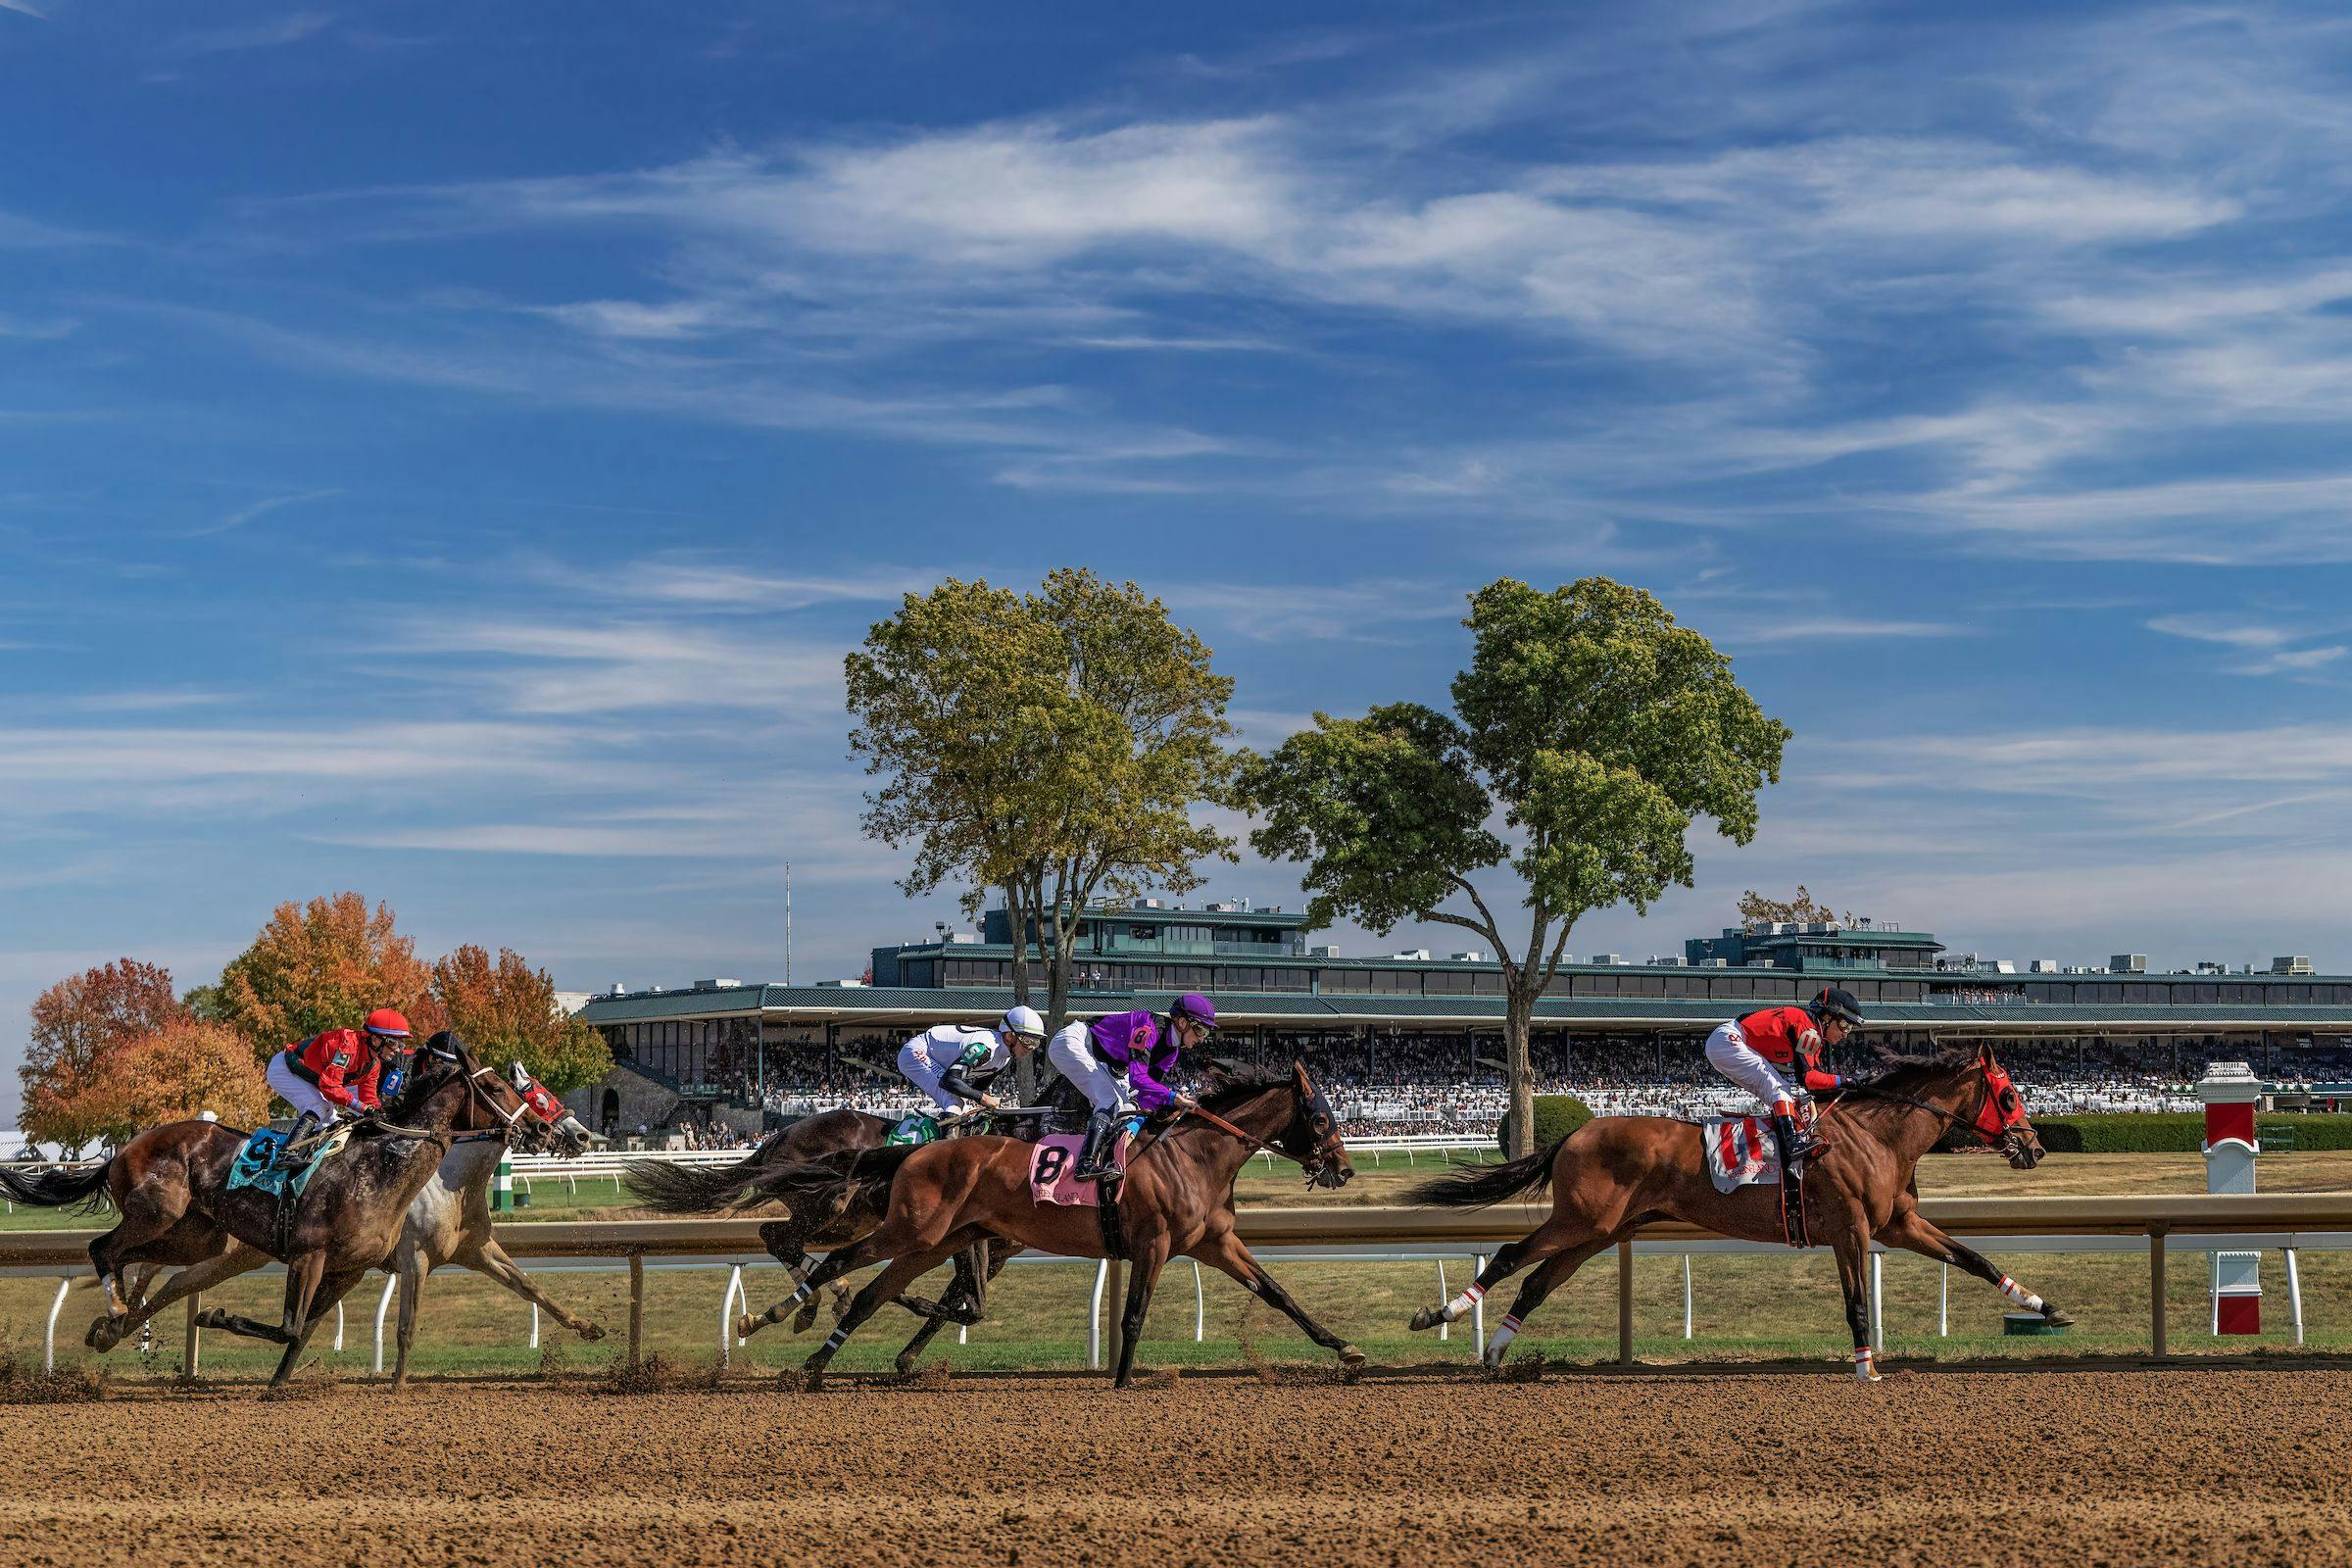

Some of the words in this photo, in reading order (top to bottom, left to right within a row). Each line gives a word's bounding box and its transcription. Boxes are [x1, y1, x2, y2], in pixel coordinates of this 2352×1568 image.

[1133, 1029, 1147, 1045] 8
[1801, 1033, 1818, 1054] 11
[963, 1044, 981, 1061] 5
[386, 1074, 400, 1091] 3
[1719, 1117, 1763, 1170] 11
[239, 1137, 276, 1179] 9
[1033, 1146, 1070, 1185] 8
